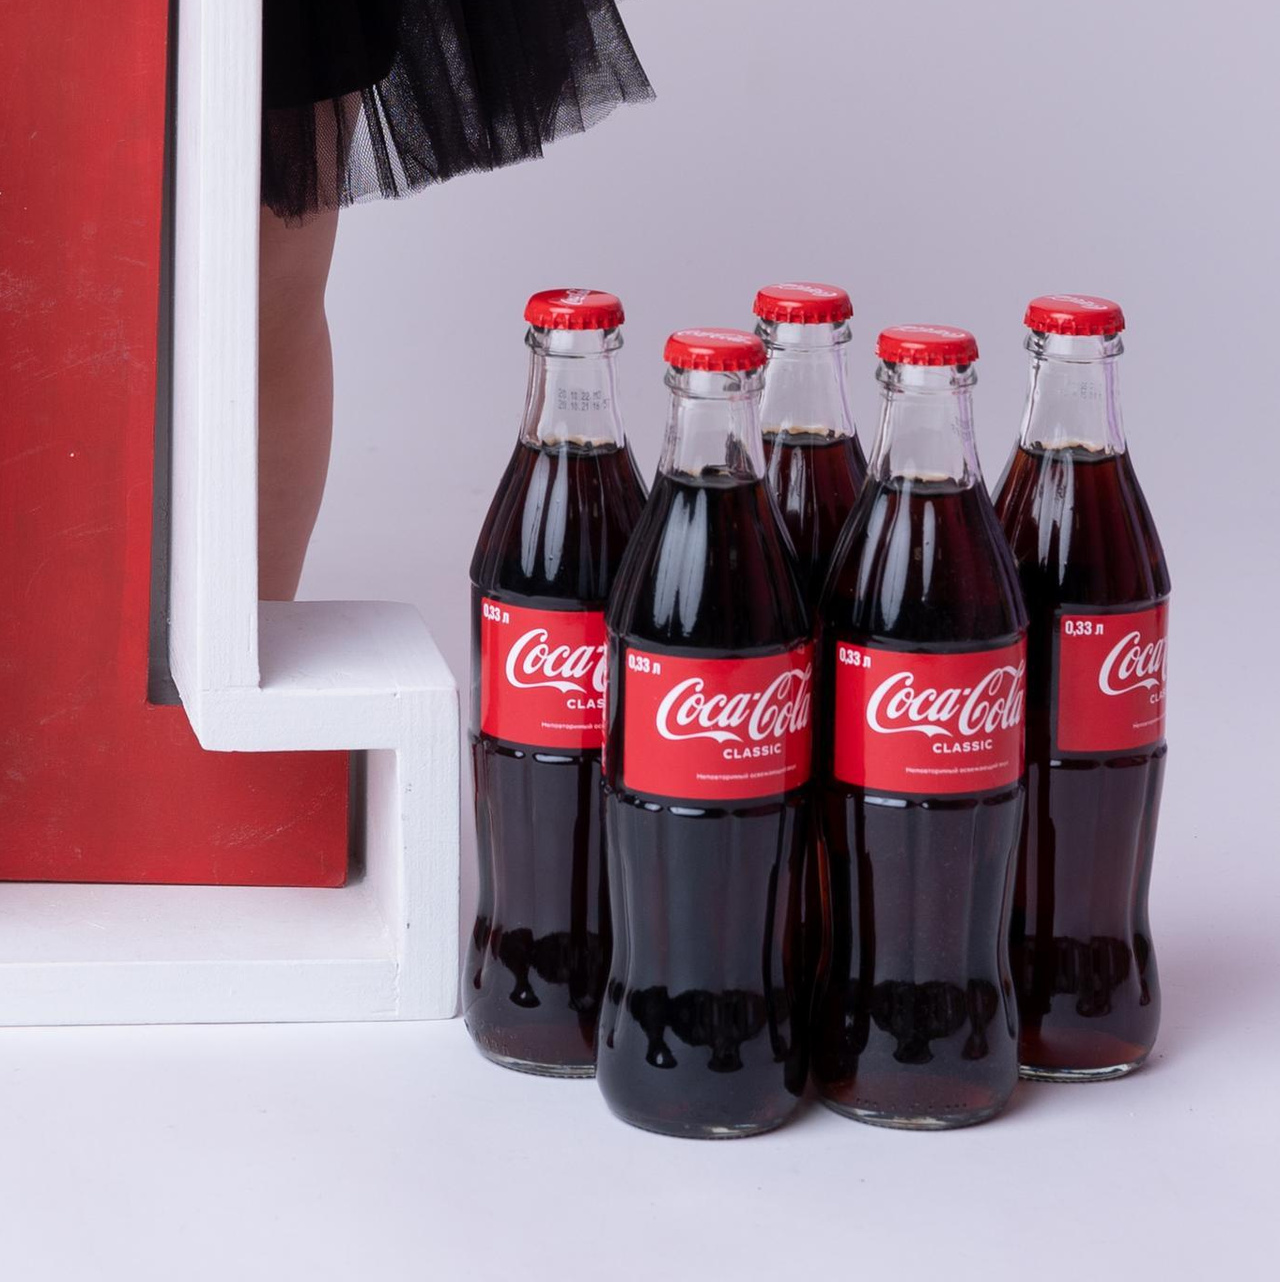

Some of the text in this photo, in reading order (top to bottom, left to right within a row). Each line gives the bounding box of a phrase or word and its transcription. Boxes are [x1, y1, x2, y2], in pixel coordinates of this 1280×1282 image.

[483, 603, 501, 623] 0,33
[1065, 620, 1092, 637] 0,33
[628, 654, 650, 673] 0,33
[839, 647, 861, 666] 0,33
[656, 662, 812, 743] Coca-Cola
[866, 659, 1026, 737] Coca-Cola
[723, 742, 782, 760] CLASSIC
[932, 739, 993, 754] CLASSIC
